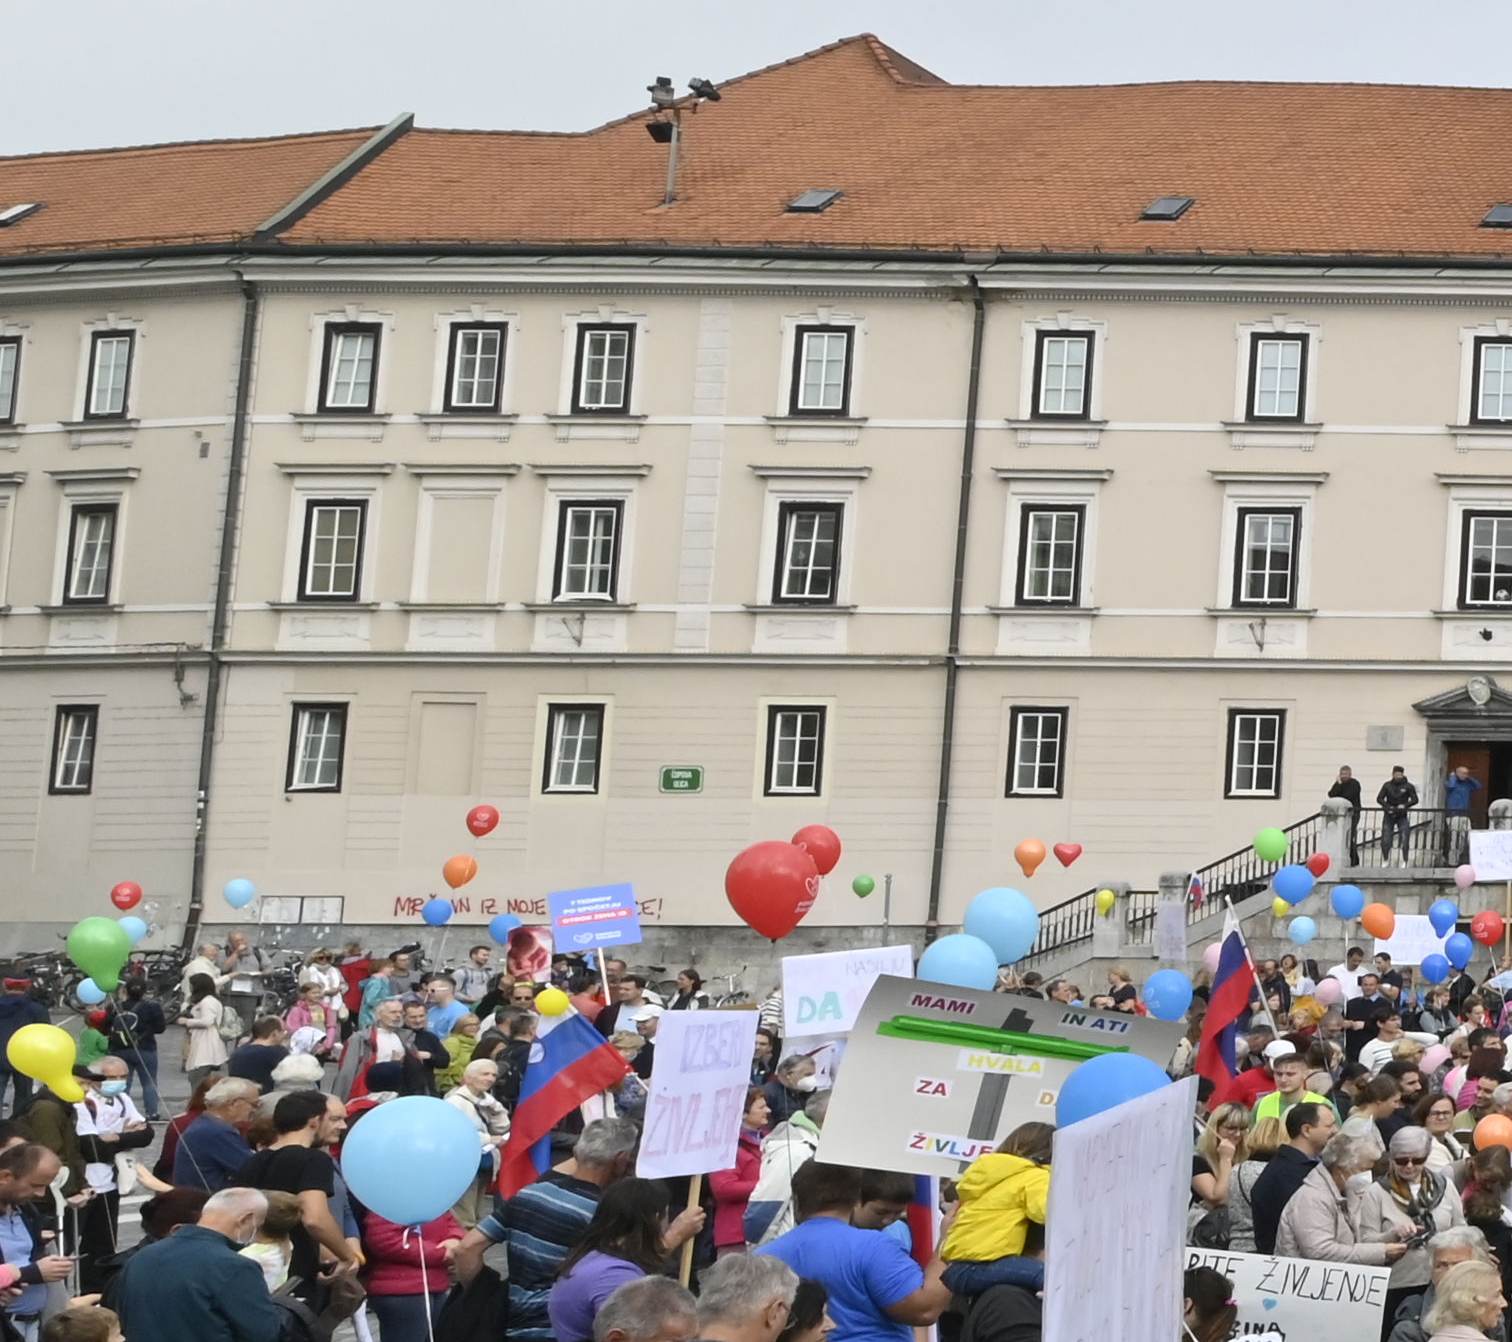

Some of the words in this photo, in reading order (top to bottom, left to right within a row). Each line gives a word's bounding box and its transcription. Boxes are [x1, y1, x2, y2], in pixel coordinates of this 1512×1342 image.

[507, 899, 546, 915] MOJE
[911, 994, 976, 1015] MAMI
[1062, 1013, 1086, 1027] IN
[967, 1054, 1042, 1074] HVALA
[916, 1080, 947, 1097] ZA
[1039, 1092, 1056, 1107] D
[909, 1131, 994, 1159] ŽIVLJE
[1256, 1257, 1388, 1307] ŽIVLJENJE
